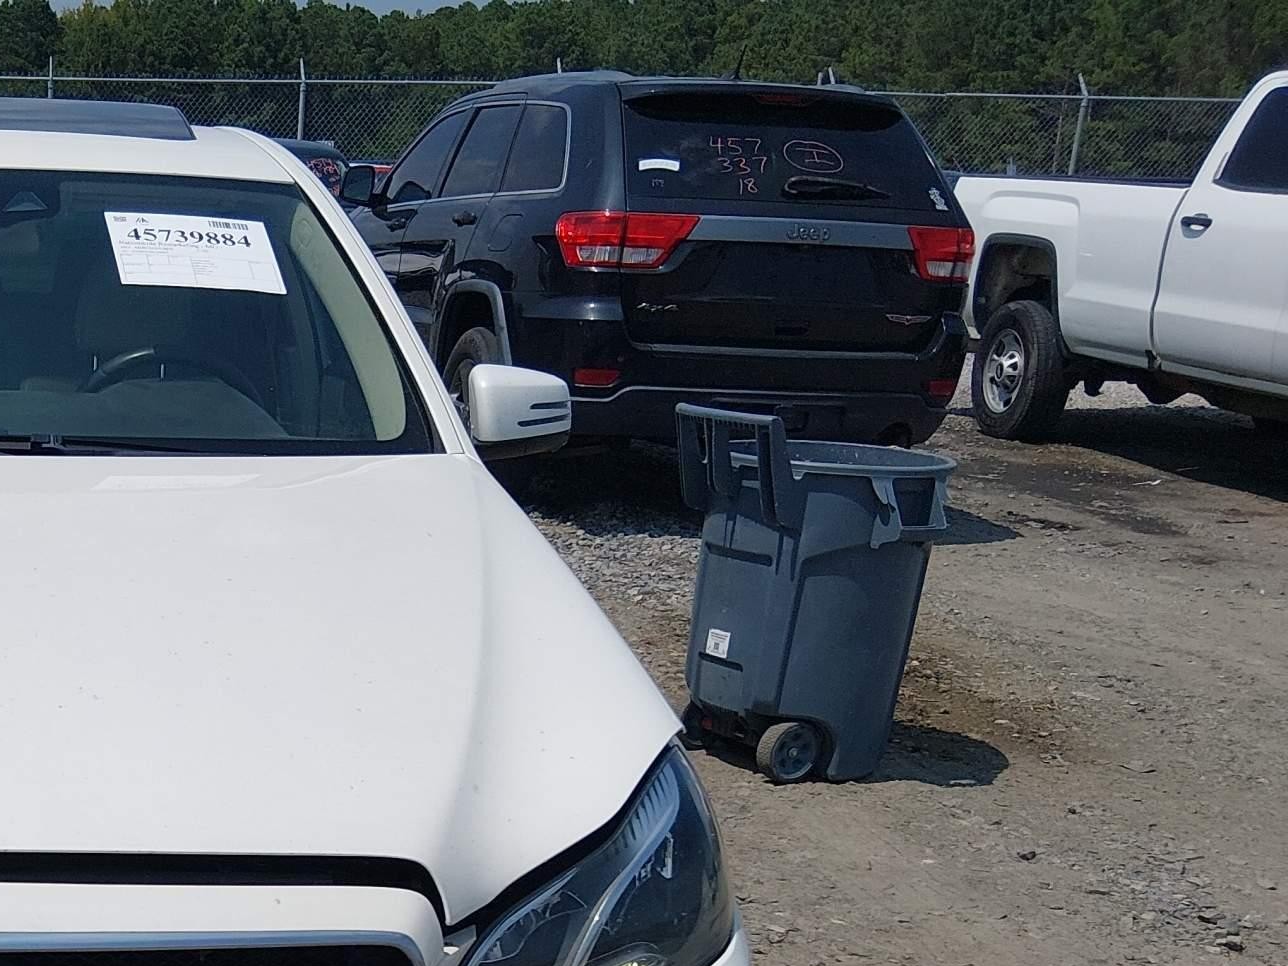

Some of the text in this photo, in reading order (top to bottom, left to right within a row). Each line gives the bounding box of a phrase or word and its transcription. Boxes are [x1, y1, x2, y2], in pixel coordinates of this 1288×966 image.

[709, 135, 762, 156] 457
[716, 156, 768, 175] 337
[738, 178, 759, 195] 18
[127, 228, 252, 248] 45739884
[785, 223, 832, 241] Jeep
